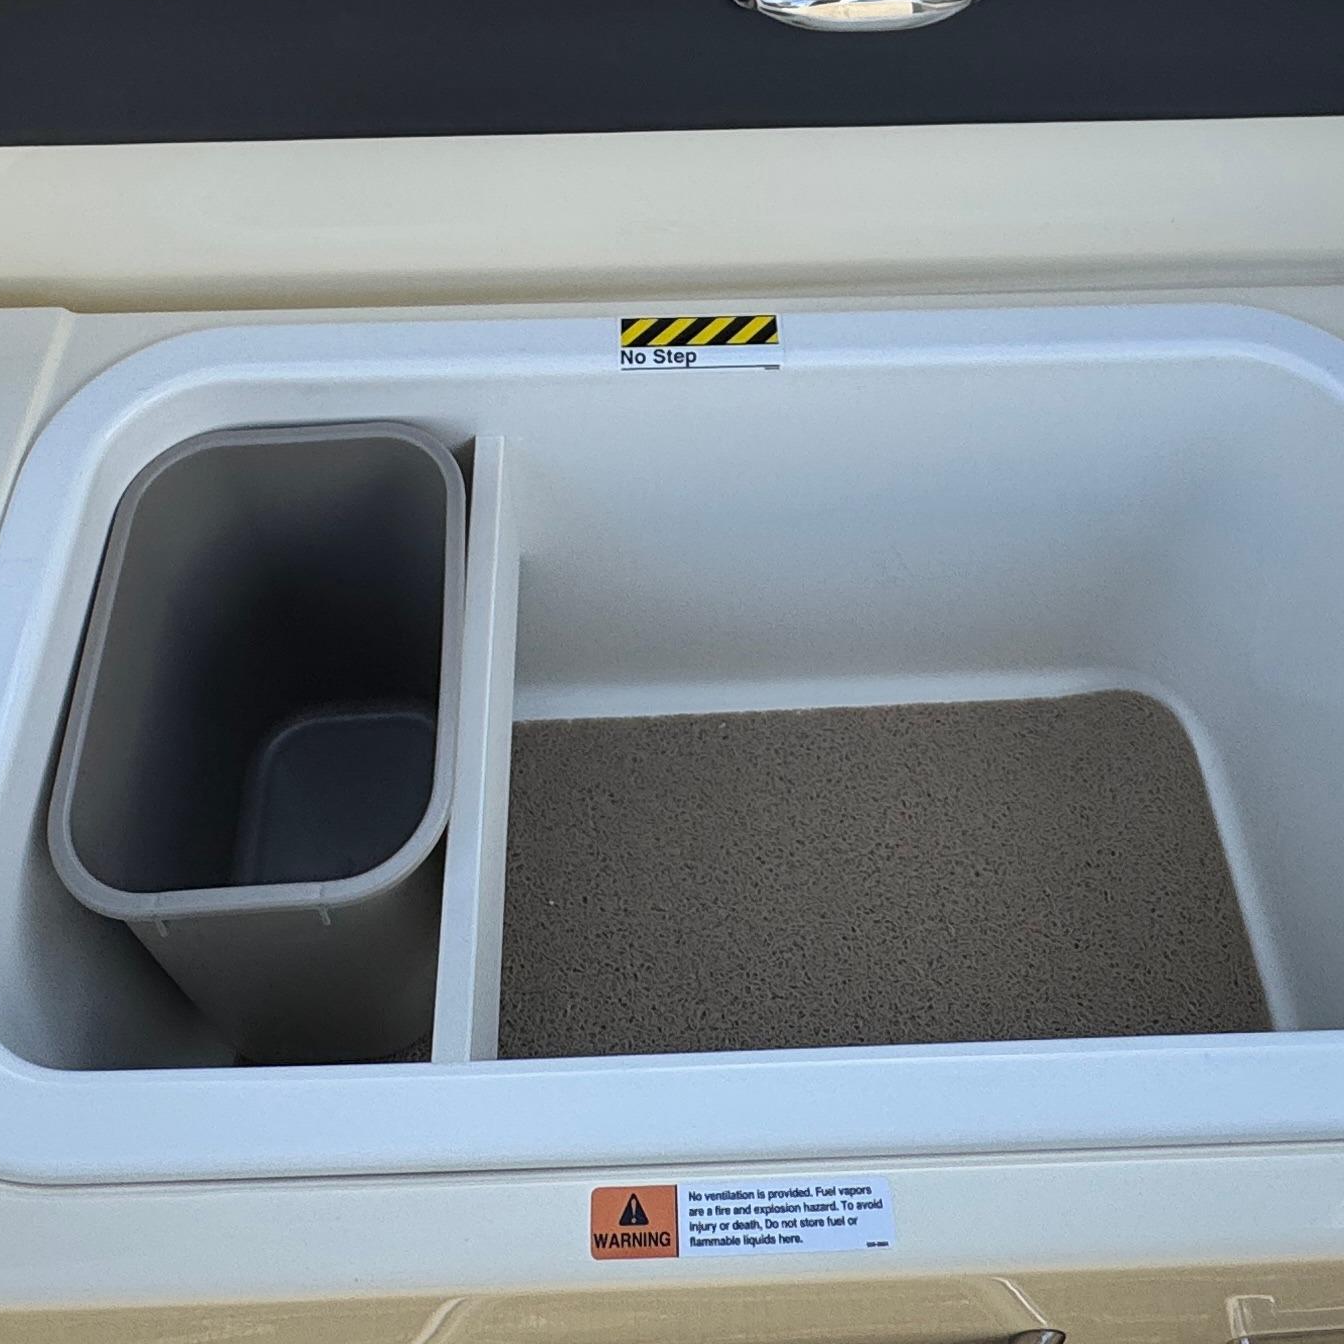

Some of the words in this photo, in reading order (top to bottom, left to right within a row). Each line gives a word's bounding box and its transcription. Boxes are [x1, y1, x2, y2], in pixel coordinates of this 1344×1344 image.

[620, 349, 646, 365] No
[653, 349, 697, 368] Step
[688, 1191, 702, 1201] No
[704, 1189, 755, 1201] ventilation
[757, 1188, 766, 1199] is
[768, 1187, 813, 1201] provided.
[815, 1186, 836, 1197] Fuel
[838, 1186, 872, 1197] vapors
[689, 1207, 704, 1217] are
[707, 1207, 713, 1216] a
[715, 1205, 731, 1216] fire
[733, 1204, 751, 1215] and
[753, 1202, 801, 1216] explosion
[803, 1201, 839, 1212] hazard.
[840, 1200, 854, 1211] To
[856, 1198, 883, 1210] avoid
[719, 1222, 730, 1231] or
[765, 1218, 779, 1229] Do
[782, 1218, 797, 1228] not
[800, 1217, 825, 1228] store
[827, 1216, 845, 1226] fuel
[847, 1216, 858, 1226] or
[593, 1231, 671, 1249] WARNING
[690, 1234, 741, 1247] flammable
[743, 1233, 776, 1248] liquids
[779, 1233, 803, 1244] here.
